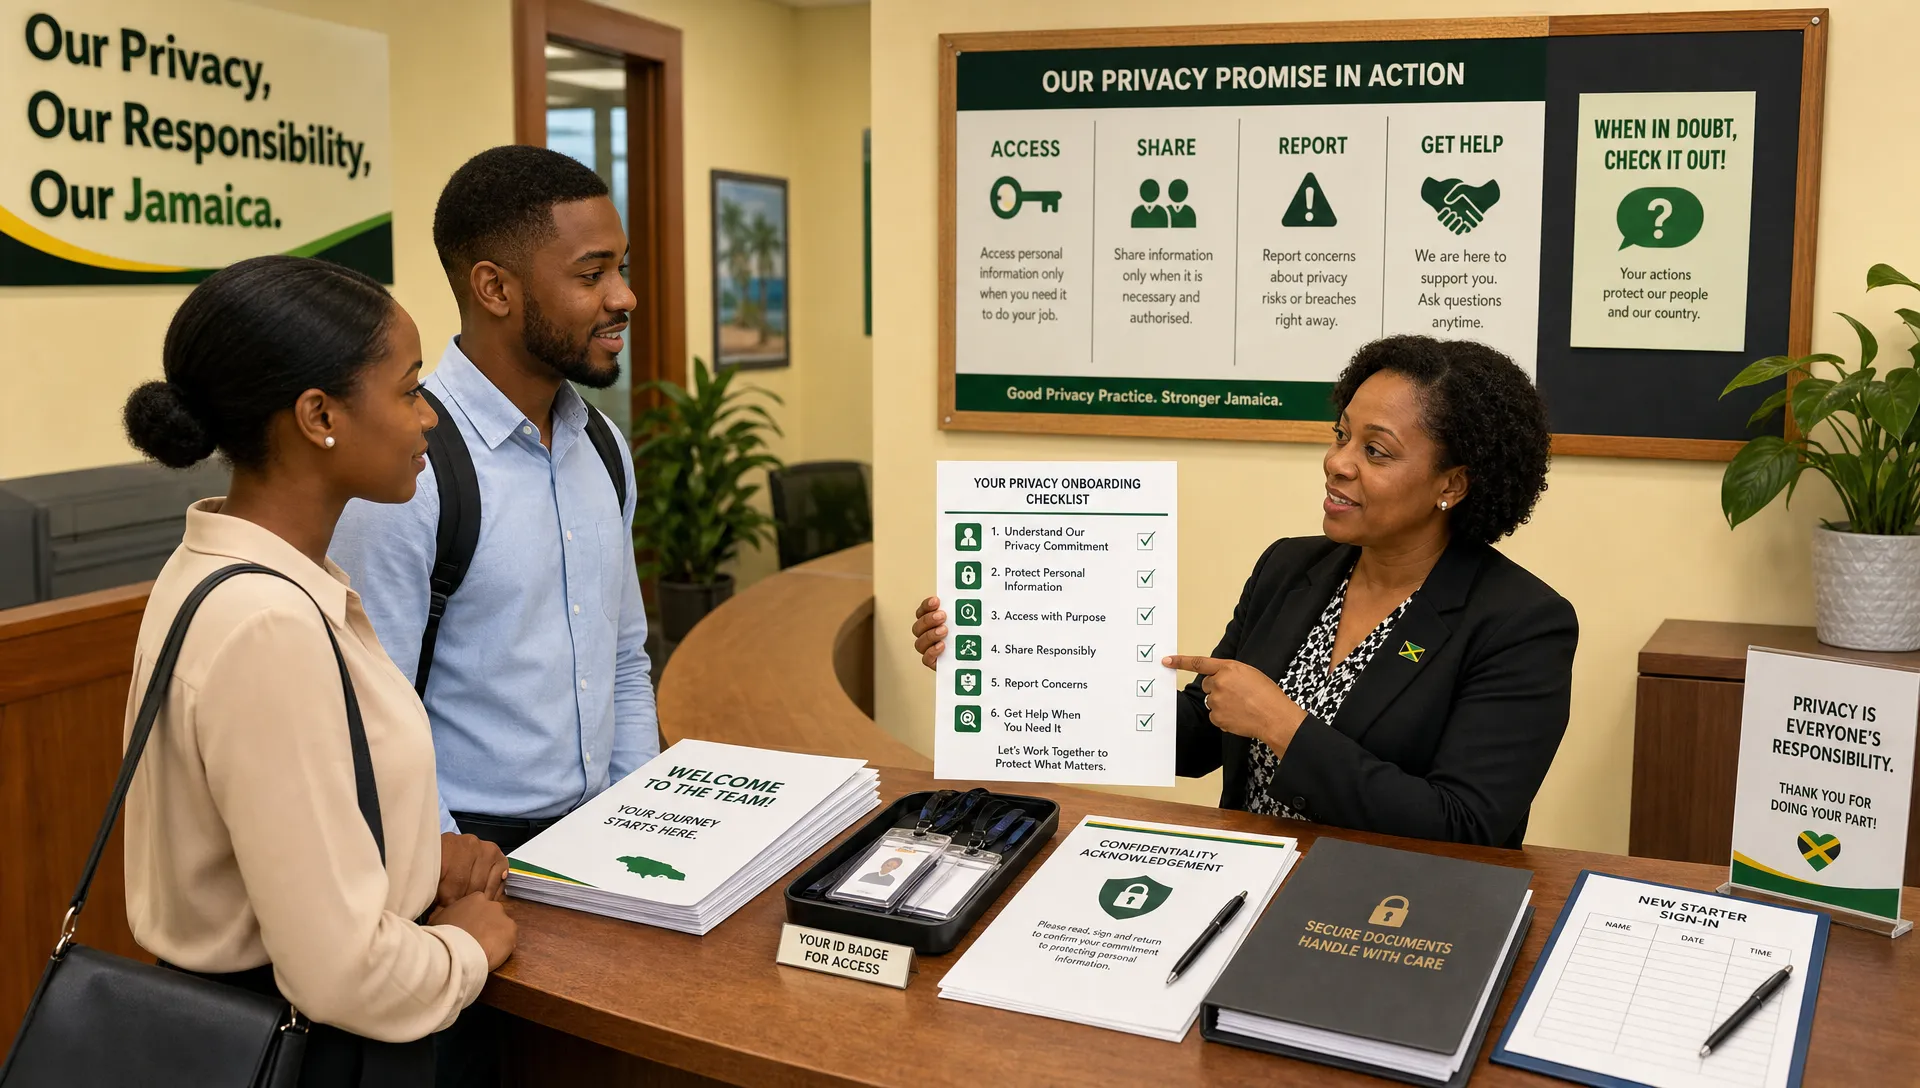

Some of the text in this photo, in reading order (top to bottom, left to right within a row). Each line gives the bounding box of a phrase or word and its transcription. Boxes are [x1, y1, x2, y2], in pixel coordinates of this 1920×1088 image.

[25, 13, 270, 102] Our Privacy,
[1042, 62, 1464, 93] OUR PRIVACY PROMISE IN ACTION
[27, 90, 370, 179] Our Responsibility,
[1594, 118, 1737, 142] WHEN IN DOUBT,
[991, 140, 1060, 157] ACCESS
[1137, 138, 1196, 156] SHARE
[1279, 136, 1348, 154] REPORT
[1421, 135, 1503, 154] GET HELP
[1605, 150, 1726, 170] CHECK IT OUT!
[30, 169, 282, 229] Our Jamaica.
[980, 247, 1063, 262] Access personal
[1114, 247, 1213, 261] Share information
[1263, 248, 1356, 265] Report concerns
[1415, 249, 1507, 263] We are here to
[980, 266, 1064, 283] information only
[1123, 268, 1203, 285] only when it is
[1270, 270, 1348, 287] about privacy
[1421, 273, 1497, 288] support you.
[1620, 267, 1691, 280] Your actions
[980, 287, 1067, 303] when you need it
[1122, 290, 1200, 306] necessary and
[1262, 291, 1356, 305] risks or breaches
[1418, 292, 1502, 310] Ask questions
[1603, 287, 1708, 303] protect our people
[982, 307, 1058, 324] to do your job.
[1130, 311, 1192, 324] authorised.
[1275, 313, 1338, 330] right away.
[1608, 305, 1700, 322] and our country.
[1432, 315, 1483, 332] anytime.
[1007, 386, 1283, 408] Good Privacy Practice. Stronger Jamaica.
[974, 478, 1141, 489] YOUR PRIVACY ONBOARDING
[1026, 493, 1090, 505] CHECKLIST
[991, 526, 1085, 537] 1. Understand Our
[1005, 540, 1108, 553] Privacy Commitment
[991, 567, 1085, 578] 2. Protect Personal
[1005, 581, 1062, 591] Information
[991, 610, 1106, 624] 3. Access with Purpose
[991, 644, 1096, 658] 4. Share Responsibly
[991, 677, 1088, 690] 5. Report Concerns
[990, 708, 1081, 721] 6. Get Help When
[1793, 696, 1876, 722] PRIVACY IS
[1004, 722, 1061, 733] You Need It
[1023, 746, 1049, 756] Work
[1052, 746, 1095, 759] Together
[1097, 749, 1108, 757] to
[1773, 738, 1893, 773] RESPONSIBILITY.
[995, 758, 1106, 771] Protect What Matters.
[667, 766, 785, 793] WELCOME
[644, 778, 776, 807] TO THE TEAM!
[1779, 782, 1871, 809] THANK YOU FOR
[618, 805, 721, 828] YOUR JOURNEY
[1771, 799, 1876, 829] DOING YOUR PART!
[604, 817, 698, 840] STARTS HERE.
[1099, 839, 1219, 860] CONFIDENTIALITY
[1080, 848, 1224, 872] ACKNOWLEDGEMENT
[1638, 896, 1747, 924] NEW STARTER
[1605, 921, 1630, 931] NAME
[1659, 911, 1719, 928] SIGN-IN
[1037, 920, 1066, 931] Please
[1093, 929, 1112, 938] sign
[1113, 932, 1132, 942] and
[1133, 937, 1162, 945] return
[1305, 920, 1453, 954] SECURE DOCUMENTS
[1681, 935, 1704, 944] DATE
[800, 933, 889, 961] YOUR ID BADGE
[1043, 934, 1078, 943] confirm
[1102, 942, 1159, 956] commitment
[1298, 935, 1445, 970] HANDLE WITH CARE
[1750, 948, 1772, 957] TIME
[805, 950, 880, 975] FOR ACCESS
[1048, 945, 1096, 958] protecting
[1097, 952, 1138, 963] personal
[1055, 955, 1111, 971] information.
